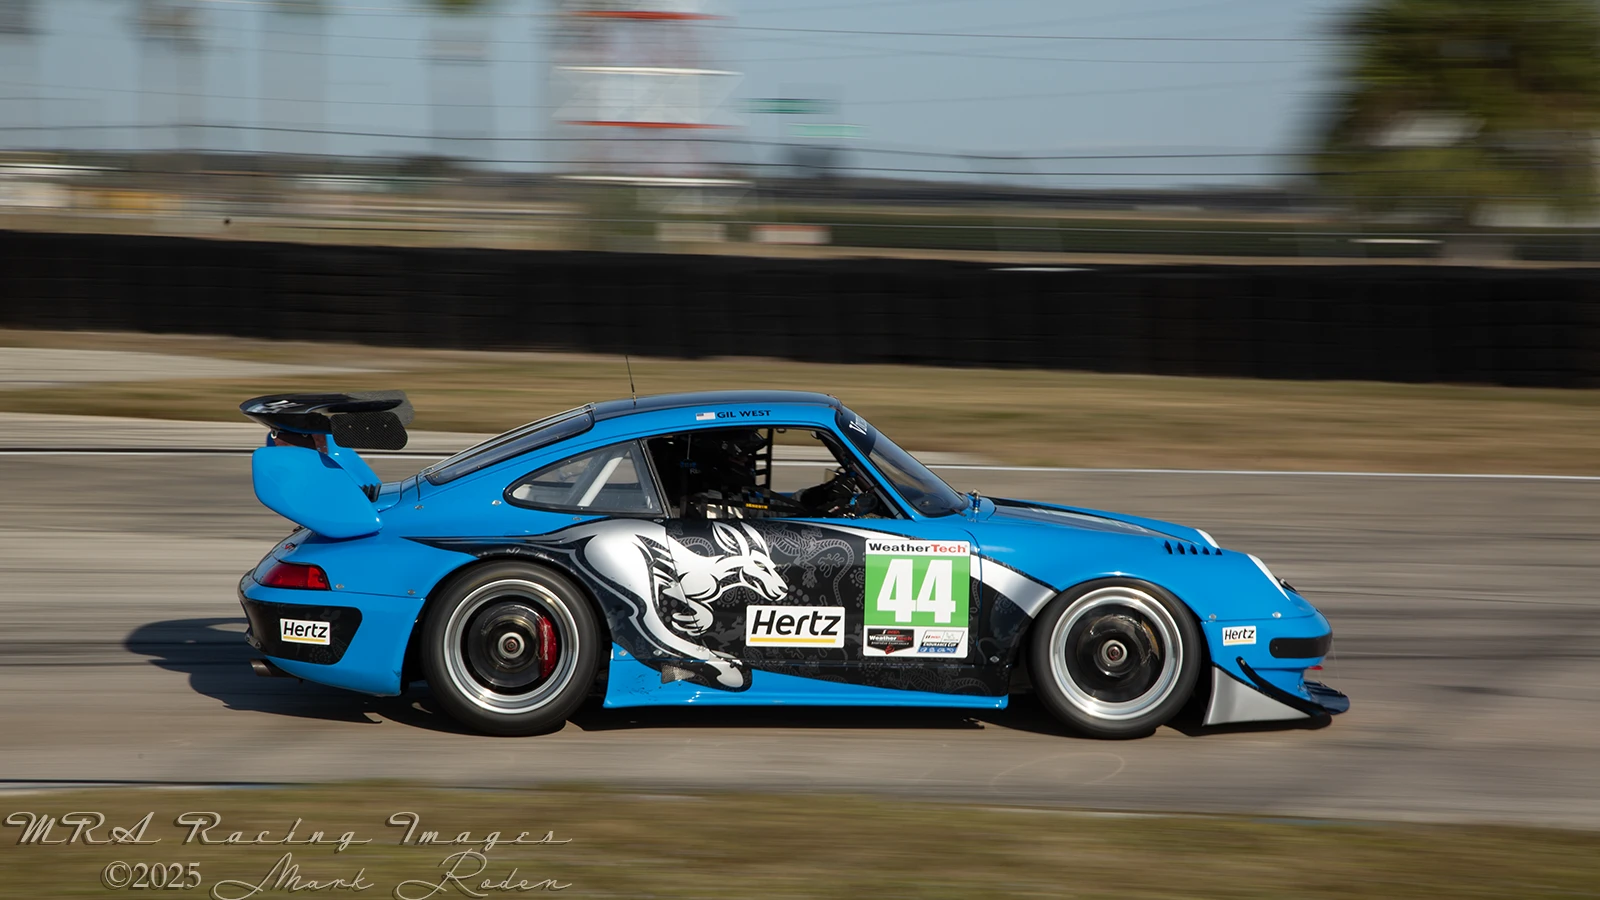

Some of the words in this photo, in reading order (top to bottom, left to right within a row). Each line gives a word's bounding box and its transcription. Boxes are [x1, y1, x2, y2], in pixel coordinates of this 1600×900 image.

[868, 543, 966, 553] WeatherTech
[877, 558, 956, 623] 44
[283, 621, 328, 638] Hertz
[751, 609, 841, 636] Hertz
[1224, 628, 1255, 640] Hertz
